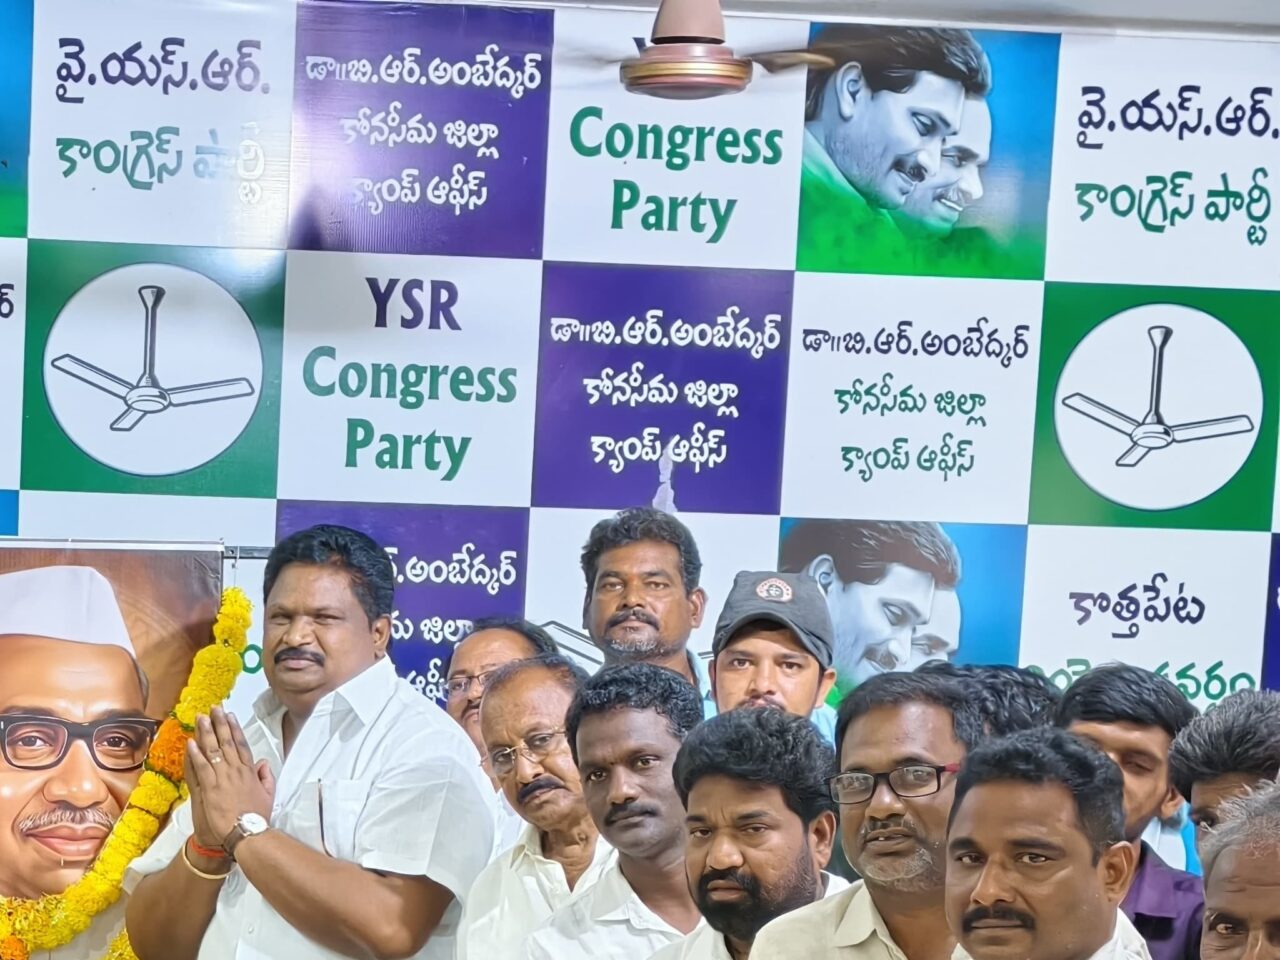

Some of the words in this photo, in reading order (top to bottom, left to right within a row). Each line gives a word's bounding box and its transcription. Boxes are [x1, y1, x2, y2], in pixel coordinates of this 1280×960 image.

[56, 37, 270, 104] వై.యస్.ఆర్.
[339, 101, 437, 147] కోనసీమ
[442, 119, 500, 160] జిల్లా
[569, 105, 783, 172] Congress
[1076, 84, 1280, 150] వై.యస్.ఆర్.
[56, 126, 183, 190] కాంగ్రెస్
[426, 163, 488, 216] ఆఫీస్
[610, 178, 738, 244] Party
[1074, 170, 1195, 234] కాంగ్రెస్
[1204, 166, 1272, 246] పార్టీ
[364, 276, 462, 331] YSR
[302, 345, 517, 410] Congress
[582, 361, 679, 407] కోనసీమ
[683, 379, 739, 418] జిల్లా
[833, 372, 927, 417] కోనసీమ
[933, 390, 987, 428] జిల్లా
[344, 417, 473, 482] Party
[590, 427, 663, 474] క్యాంప్
[669, 421, 728, 474] ఆఫీస్
[840, 437, 910, 483] క్యాంప్
[916, 431, 975, 482] ఆఫీస్
[1068, 572, 1206, 639] కొత్తపేట
